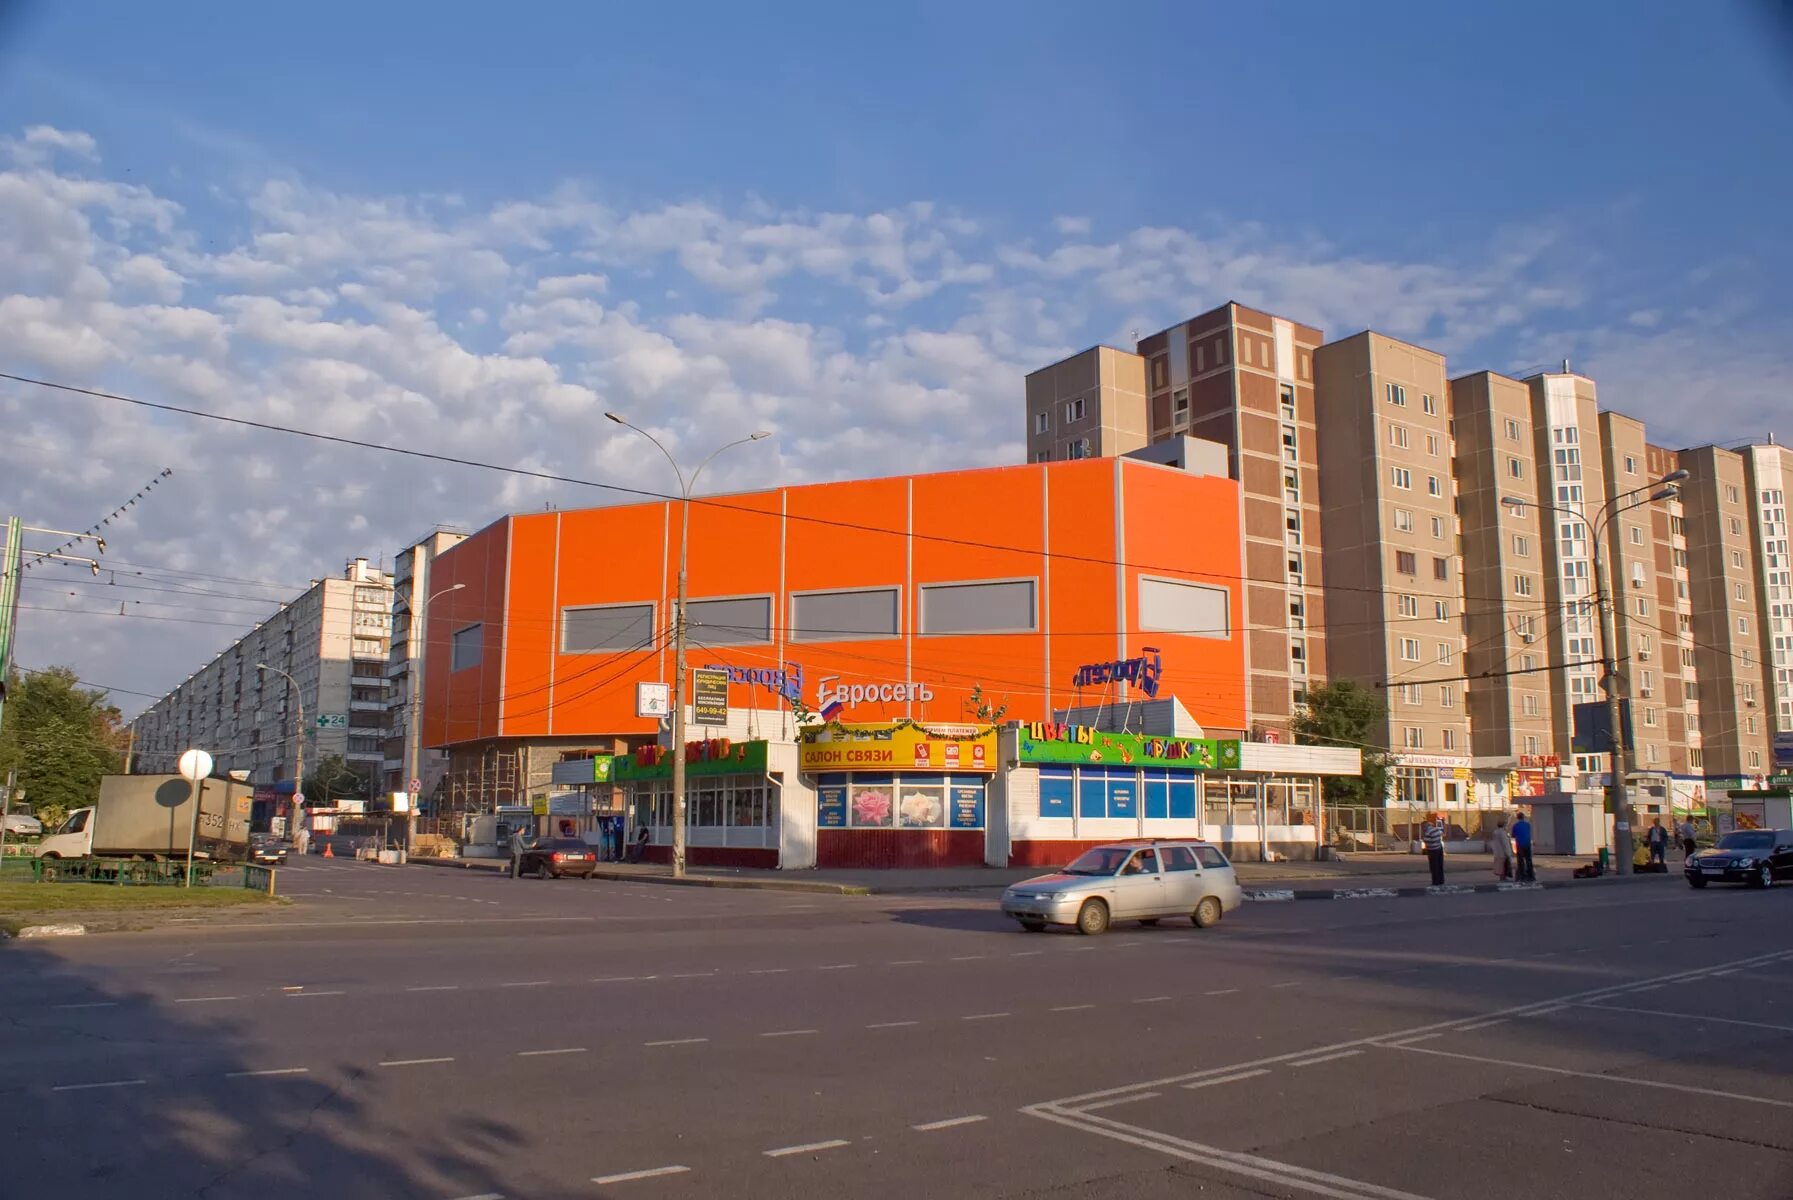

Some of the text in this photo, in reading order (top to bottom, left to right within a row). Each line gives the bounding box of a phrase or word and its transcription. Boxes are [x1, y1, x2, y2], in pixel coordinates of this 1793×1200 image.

[816, 675, 934, 709] Евросеть
[332, 715, 345, 724] 24
[1029, 721, 1094, 744] ЦВЕТЫ
[805, 750, 893, 763] САЛОН СВЯЗИ
